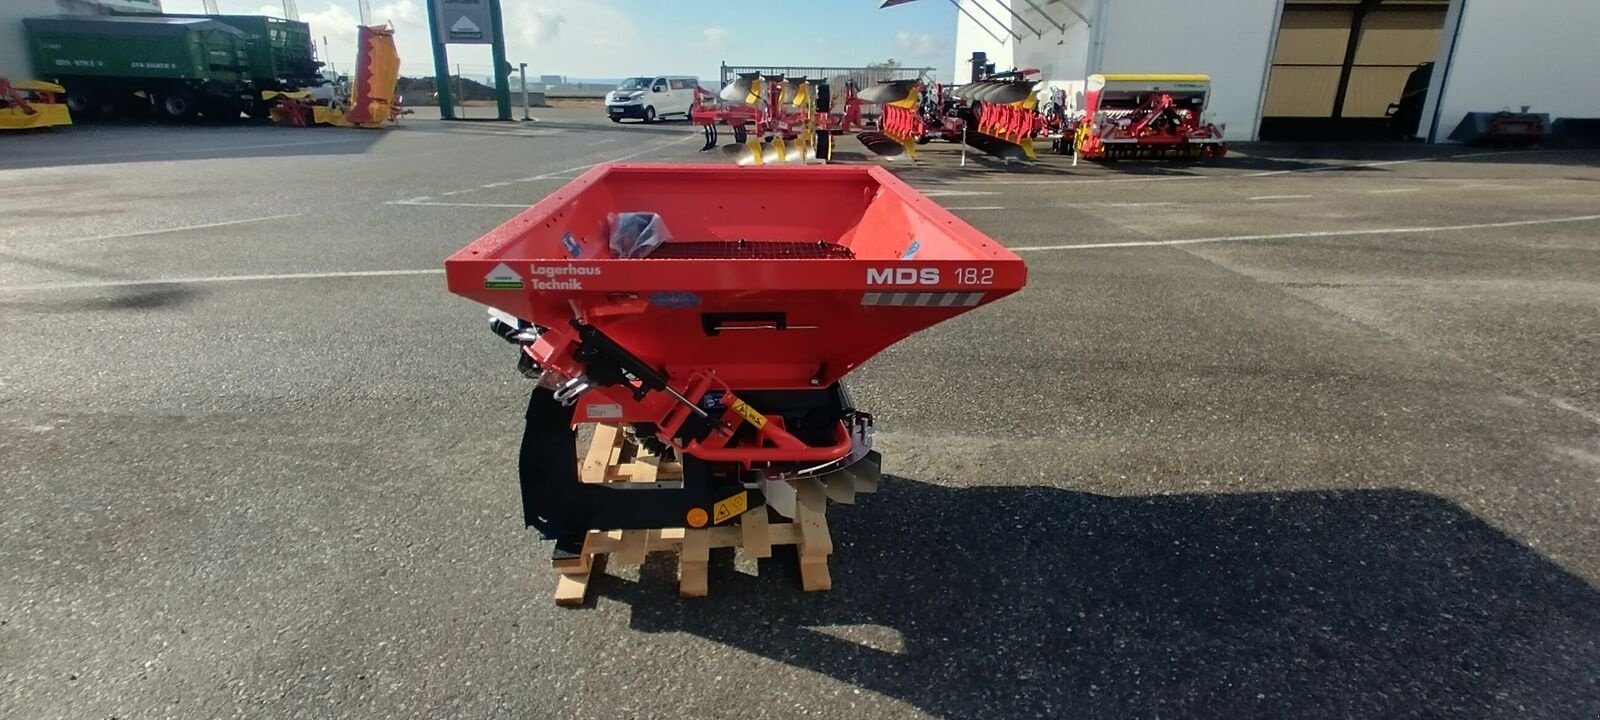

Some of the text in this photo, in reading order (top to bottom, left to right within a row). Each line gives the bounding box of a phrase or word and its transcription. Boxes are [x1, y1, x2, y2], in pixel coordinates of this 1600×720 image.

[530, 263, 602, 278] Lagerhaus
[866, 267, 994, 285] MDS 18.2
[531, 279, 583, 291] Technik
